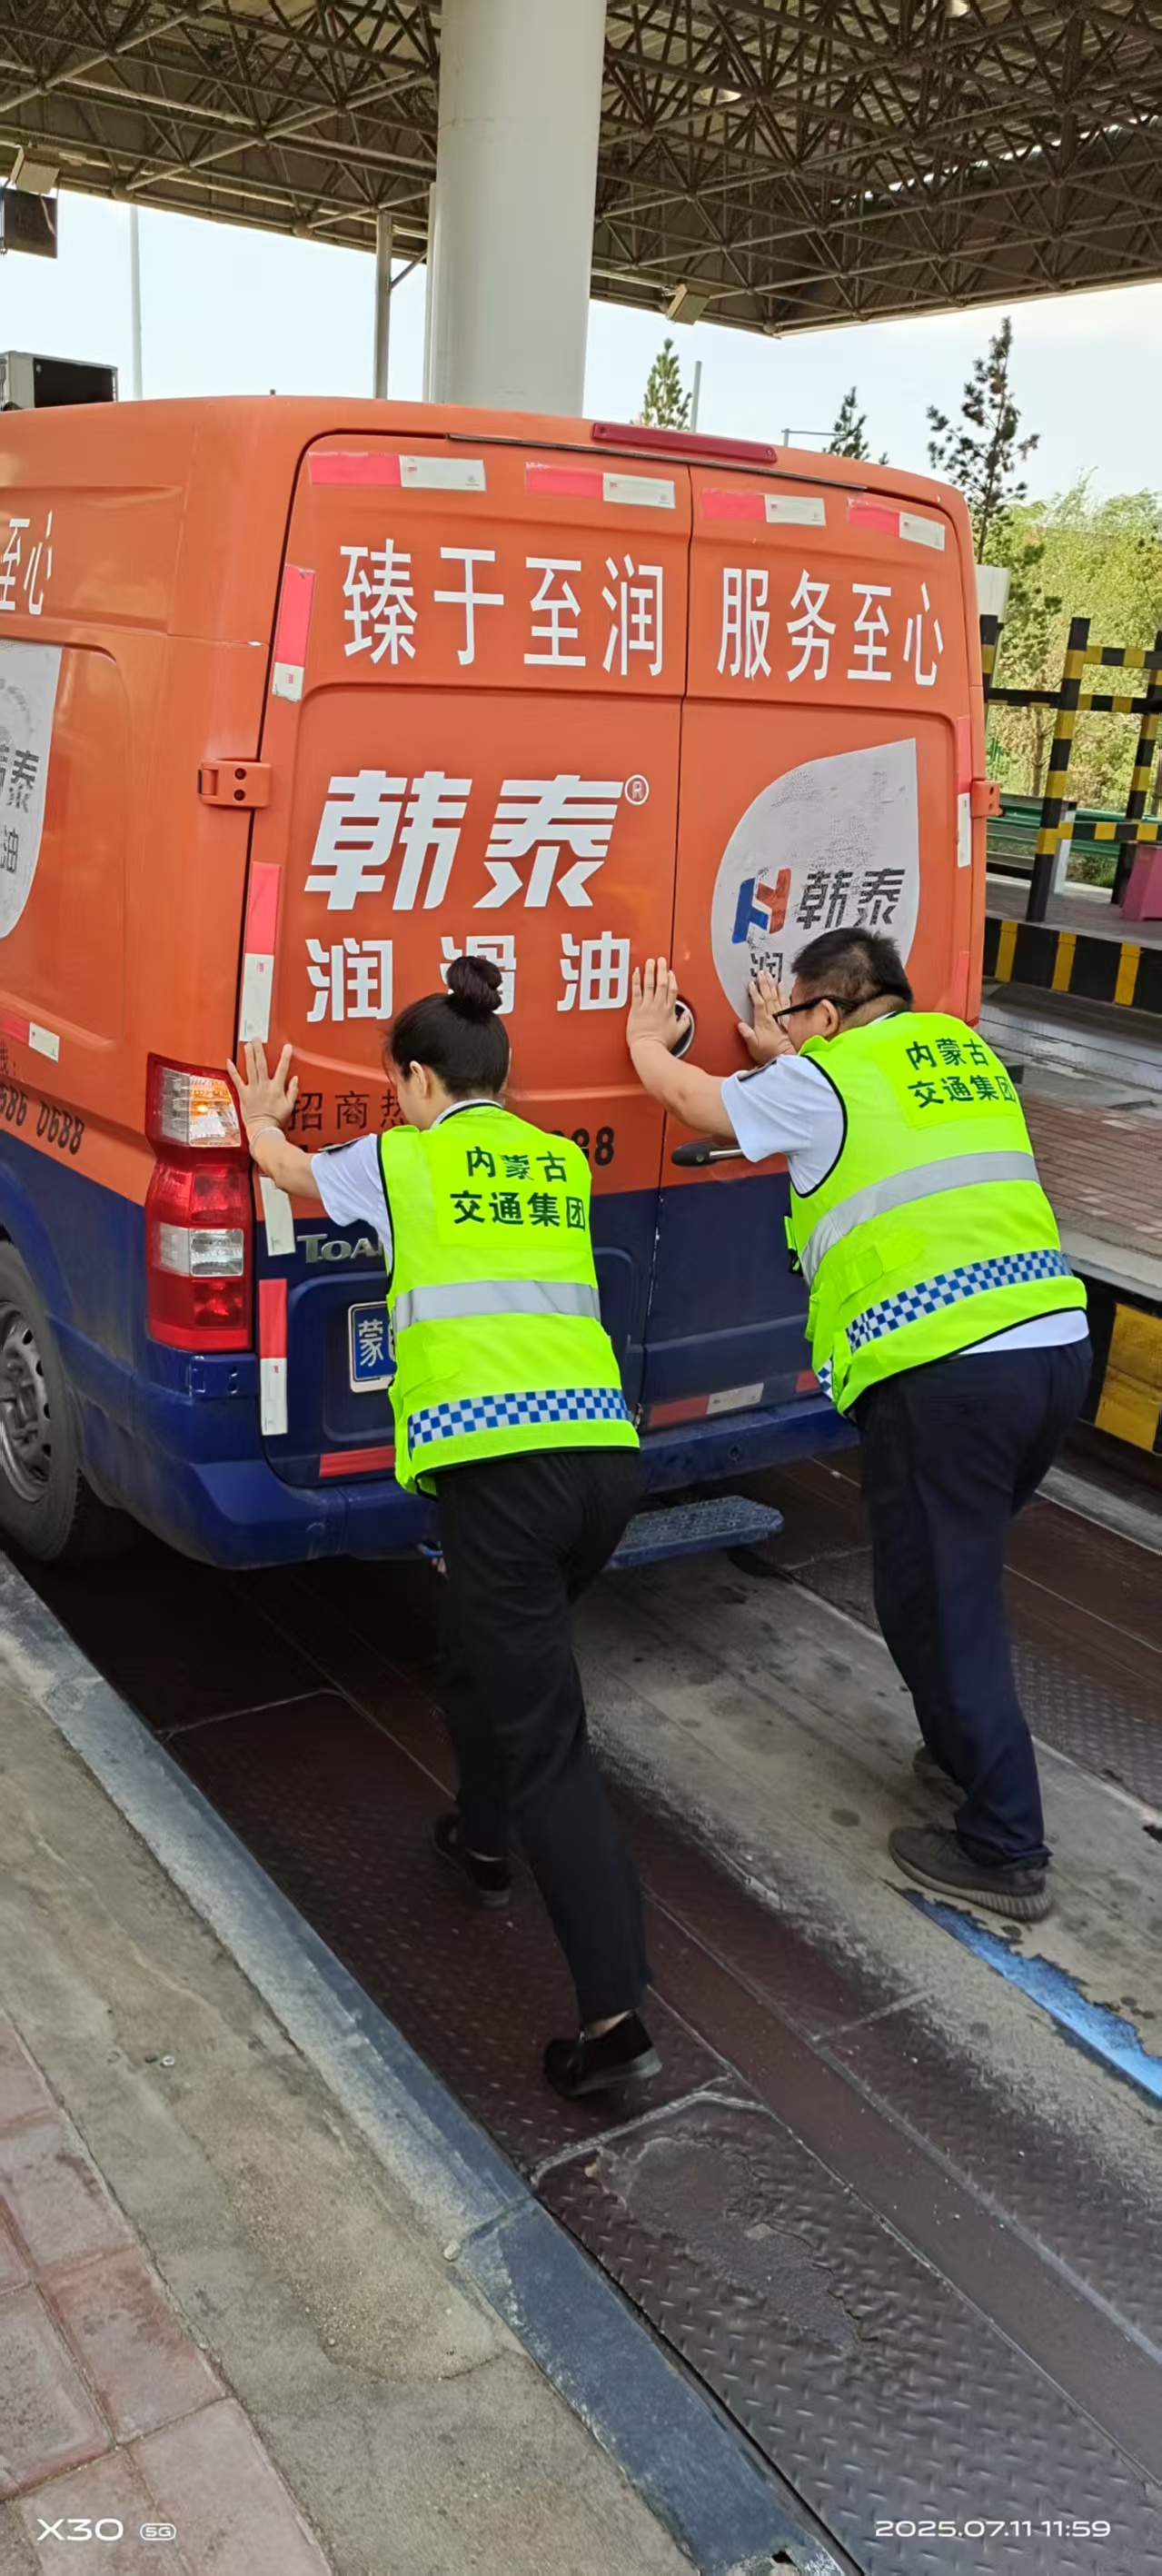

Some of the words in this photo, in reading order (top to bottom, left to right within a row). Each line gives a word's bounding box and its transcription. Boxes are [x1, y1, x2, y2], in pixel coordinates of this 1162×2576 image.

[340, 538, 664, 676] 臻于至润
[716, 567, 945, 686] 服务至心
[0, 743, 40, 813] 泰
[304, 770, 624, 910] 韩泰
[796, 868, 906, 930] 韩泰
[906, 1038, 988, 1070] 内蒙古
[908, 1075, 1018, 1109] 交通集团
[37, 1099, 84, 1156] 0688
[466, 1146, 568, 1182] 内蒙古
[450, 1189, 586, 1231] 交通集团
